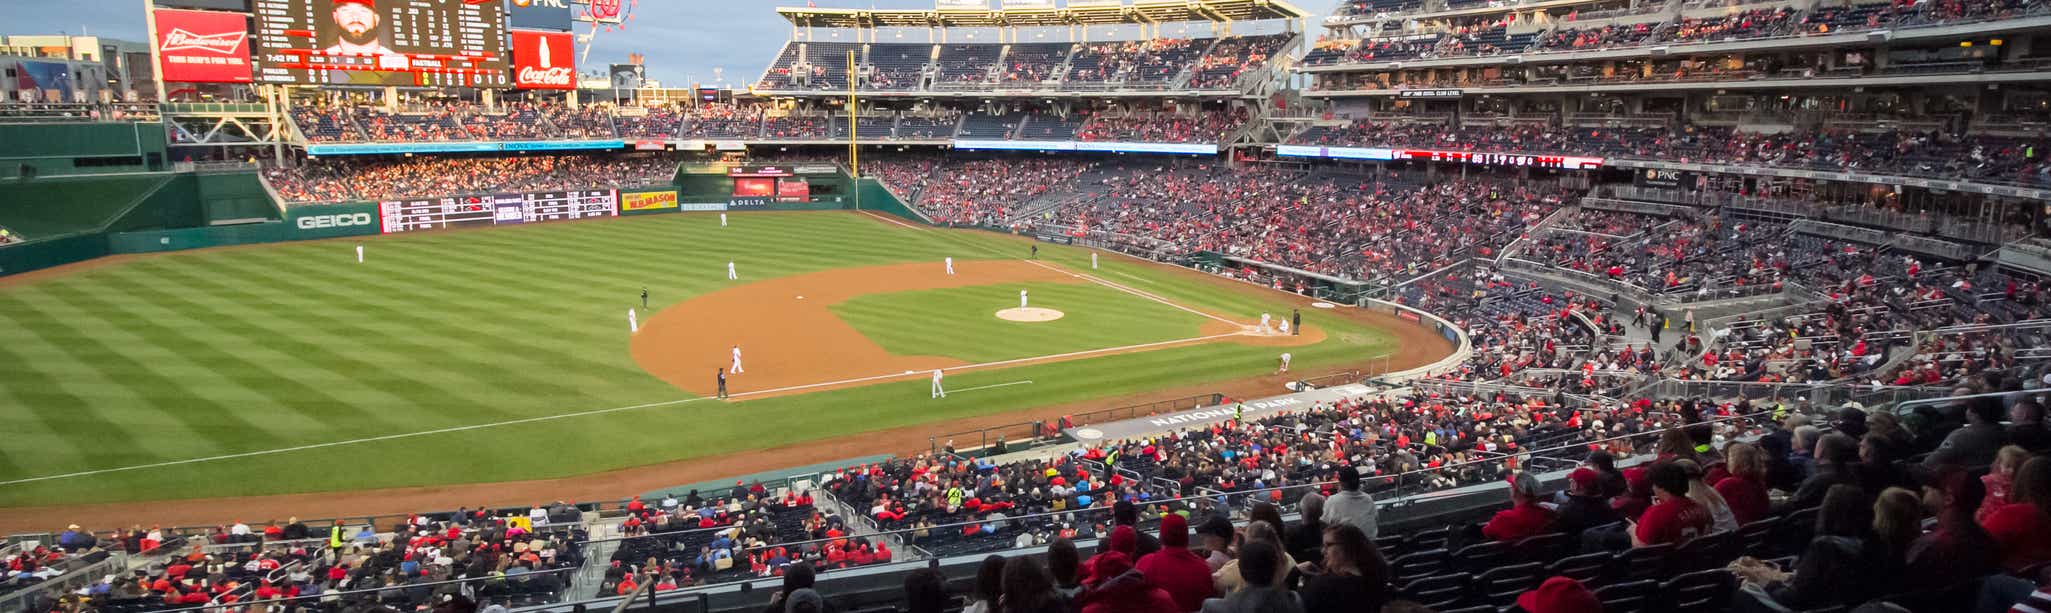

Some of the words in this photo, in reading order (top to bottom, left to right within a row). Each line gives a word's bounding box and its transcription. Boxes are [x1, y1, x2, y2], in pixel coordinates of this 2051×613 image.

[166, 33, 239, 47] Budweiser
[519, 66, 572, 85] Coca-Cola
[1657, 171, 1680, 181] PNC
[297, 212, 372, 230] GEICO
[1255, 397, 1299, 409] PARK
